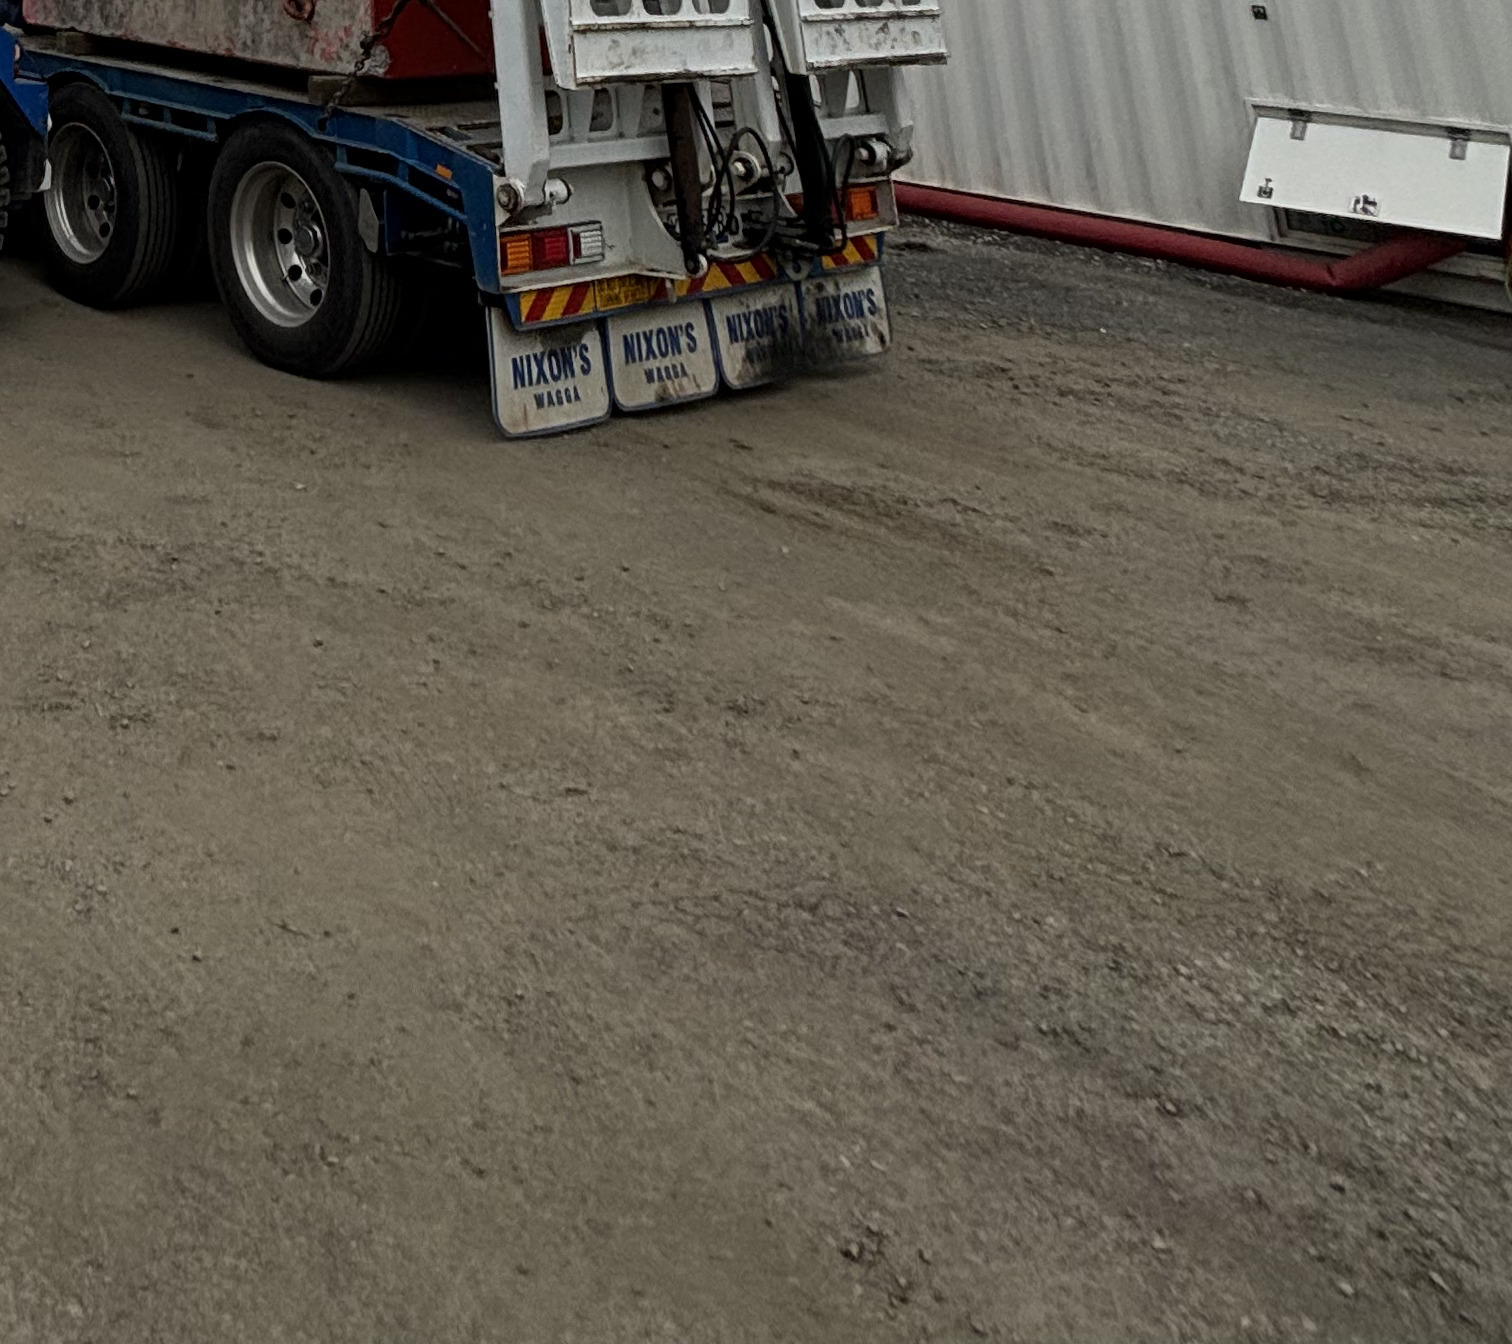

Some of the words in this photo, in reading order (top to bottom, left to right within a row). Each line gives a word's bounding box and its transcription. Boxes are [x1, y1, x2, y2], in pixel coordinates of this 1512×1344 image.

[622, 321, 697, 366] NIXON'S
[726, 303, 789, 344] NIXON'S
[511, 343, 592, 390] NIXON'S
[644, 362, 689, 384] WAGGA
[534, 385, 581, 410] WAGGA
